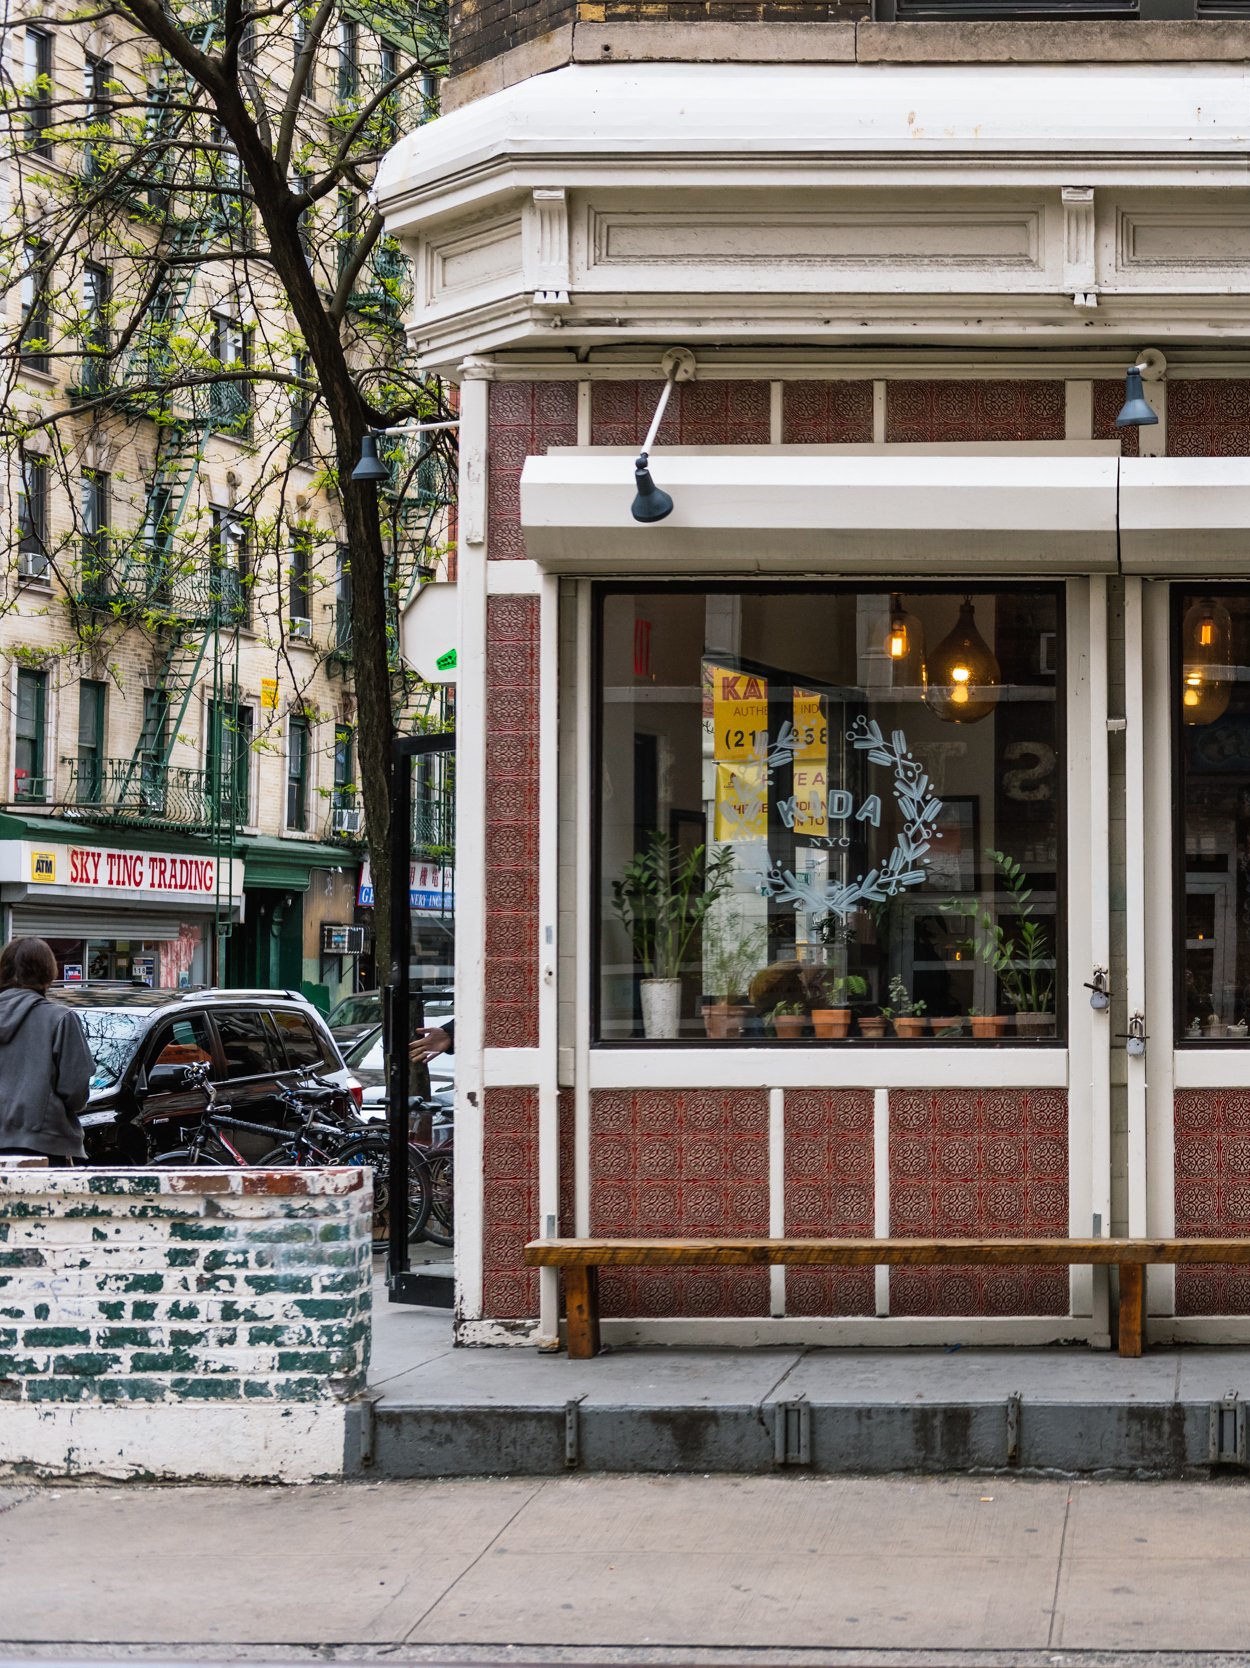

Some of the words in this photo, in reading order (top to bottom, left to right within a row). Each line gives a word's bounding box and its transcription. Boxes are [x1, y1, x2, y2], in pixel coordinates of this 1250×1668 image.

[721, 675, 768, 701] KA
[776, 789, 882, 828] KIDA
[809, 837, 850, 848] NYC
[35, 858, 53, 874] ATM
[70, 850, 102, 884] SKY
[106, 853, 144, 888] TING
[148, 856, 214, 892] TRADING
[133, 966, 147, 976] 118
